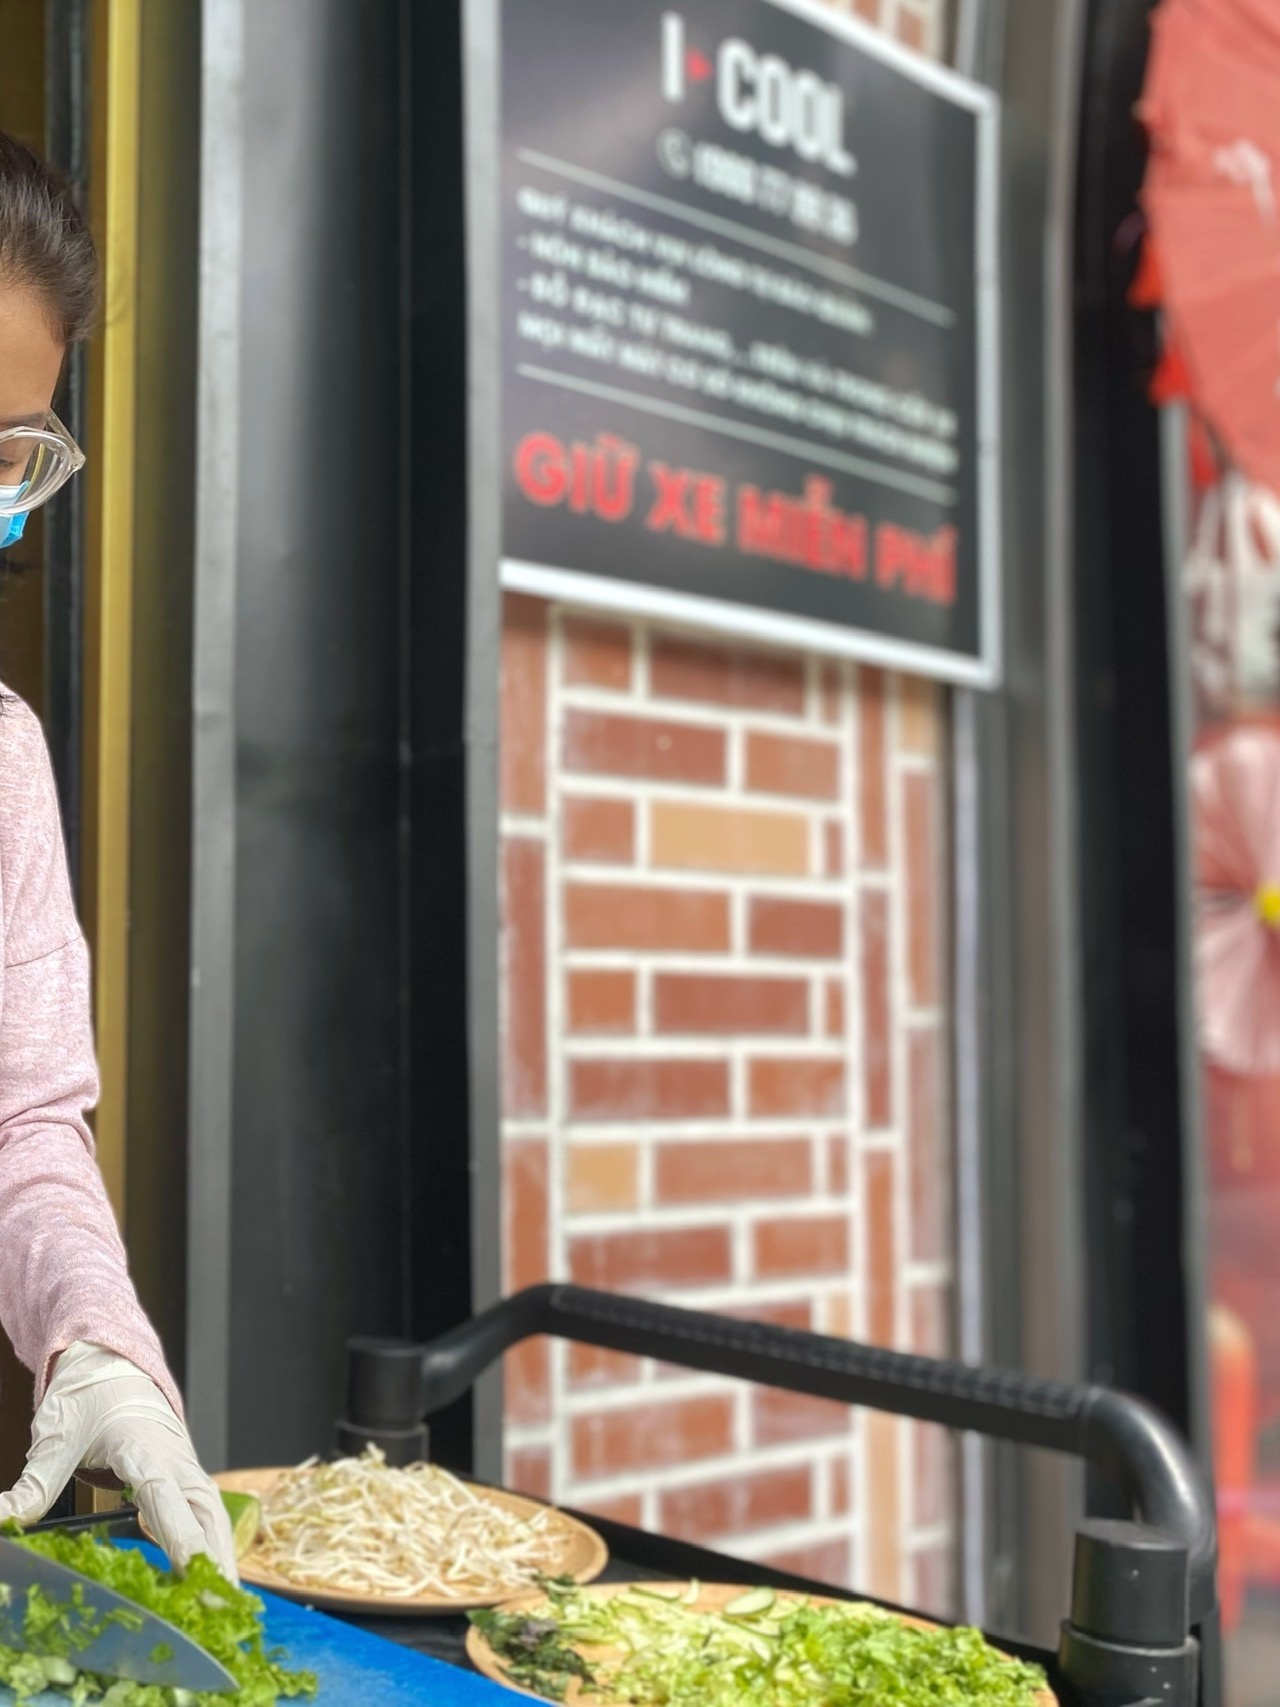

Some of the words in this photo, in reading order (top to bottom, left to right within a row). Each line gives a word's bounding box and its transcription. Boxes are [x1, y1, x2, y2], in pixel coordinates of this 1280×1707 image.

[662, 11, 684, 102] I
[717, 37, 857, 178] COOL
[647, 465, 724, 543] XE
